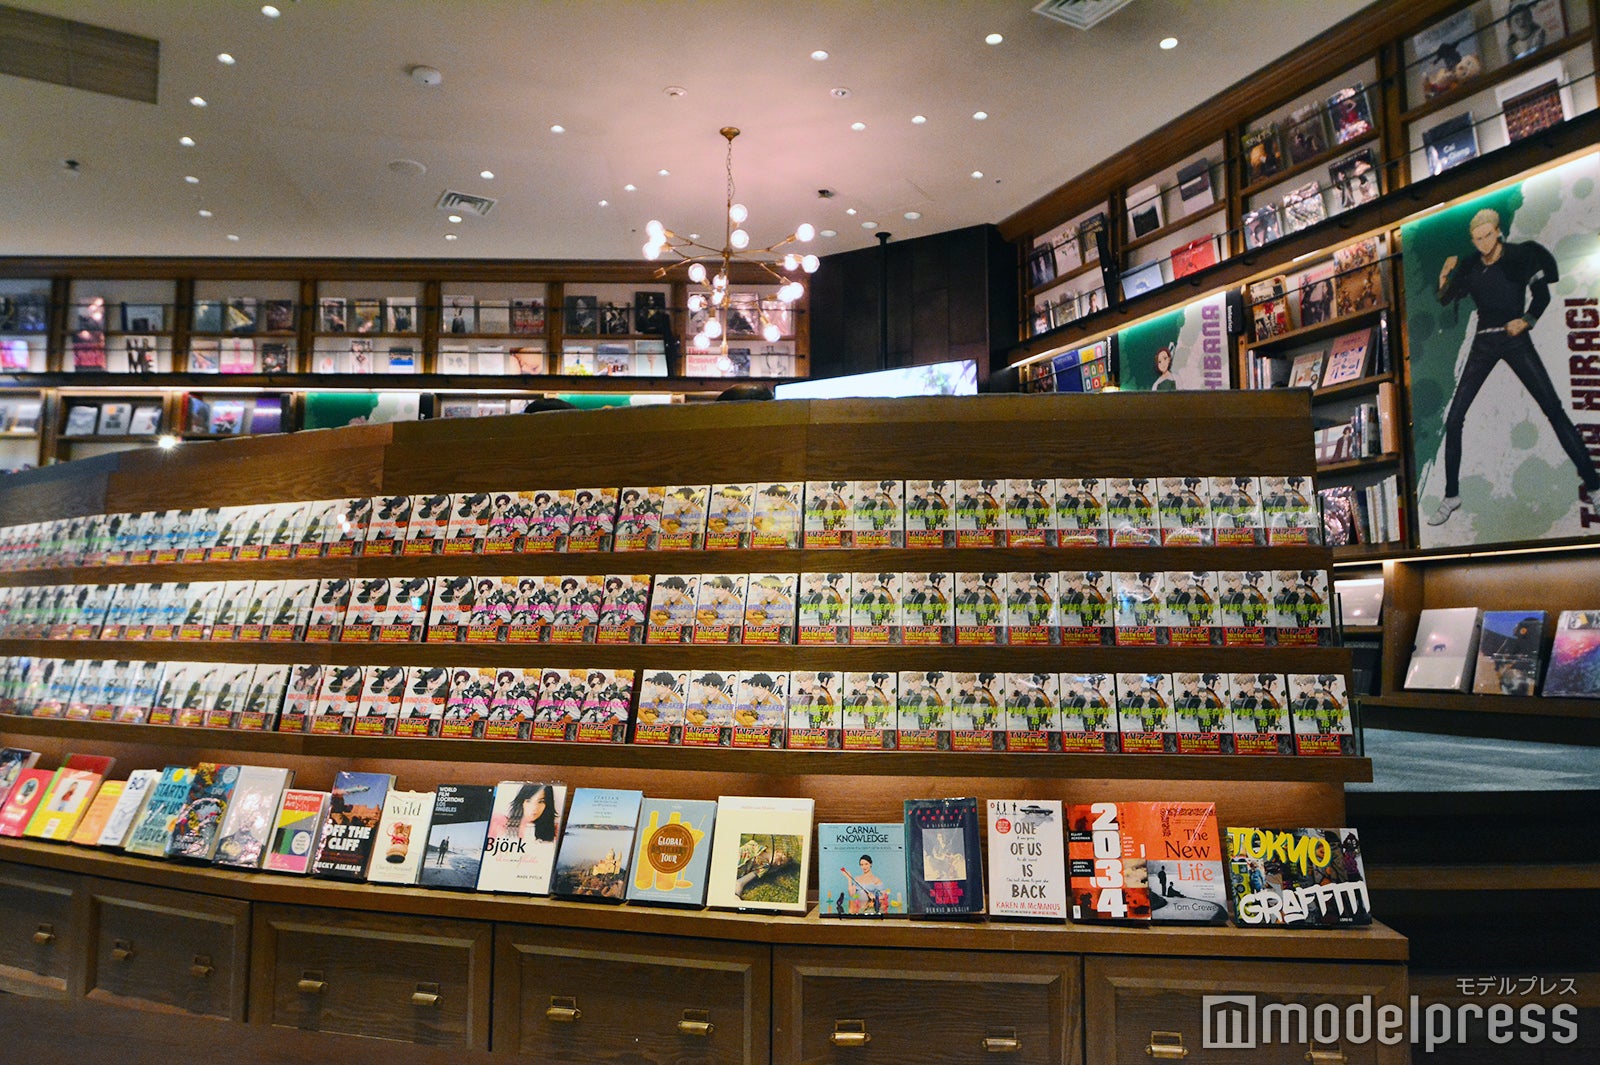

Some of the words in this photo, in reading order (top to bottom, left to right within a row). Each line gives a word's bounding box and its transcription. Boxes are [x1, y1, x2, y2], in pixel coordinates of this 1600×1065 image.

[1181, 734, 1218, 742] TVアニメ
[1237, 734, 1275, 742] TVアニメ
[1299, 735, 1337, 743] TVアニメ
[154, 783, 188, 799] STARTS
[287, 793, 321, 803] Destination
[392, 801, 422, 817] wild
[325, 824, 346, 838] OFF
[348, 825, 372, 839] THE
[846, 826, 879, 835] CARNAL
[1014, 822, 1037, 835] ONE
[1183, 828, 1208, 841] The
[328, 837, 361, 852] CLIFF
[657, 836, 684, 847] GLOBAL
[836, 835, 889, 843] KNOWLEDGE
[484, 837, 527, 856] Björk
[1010, 842, 1024, 855] OF
[1027, 842, 1042, 856] US
[1165, 840, 1211, 859] New
[1227, 827, 1331, 876] TOKYO
[660, 853, 679, 864] TOUR
[335, 863, 362, 872] AIKMAN
[1022, 864, 1033, 877] IS
[1177, 863, 1214, 881] Life
[1012, 884, 1046, 899] BACK
[996, 901, 1019, 909] KAREN
[1173, 903, 1190, 911] Tom
[1191, 903, 1218, 911] Crewe
